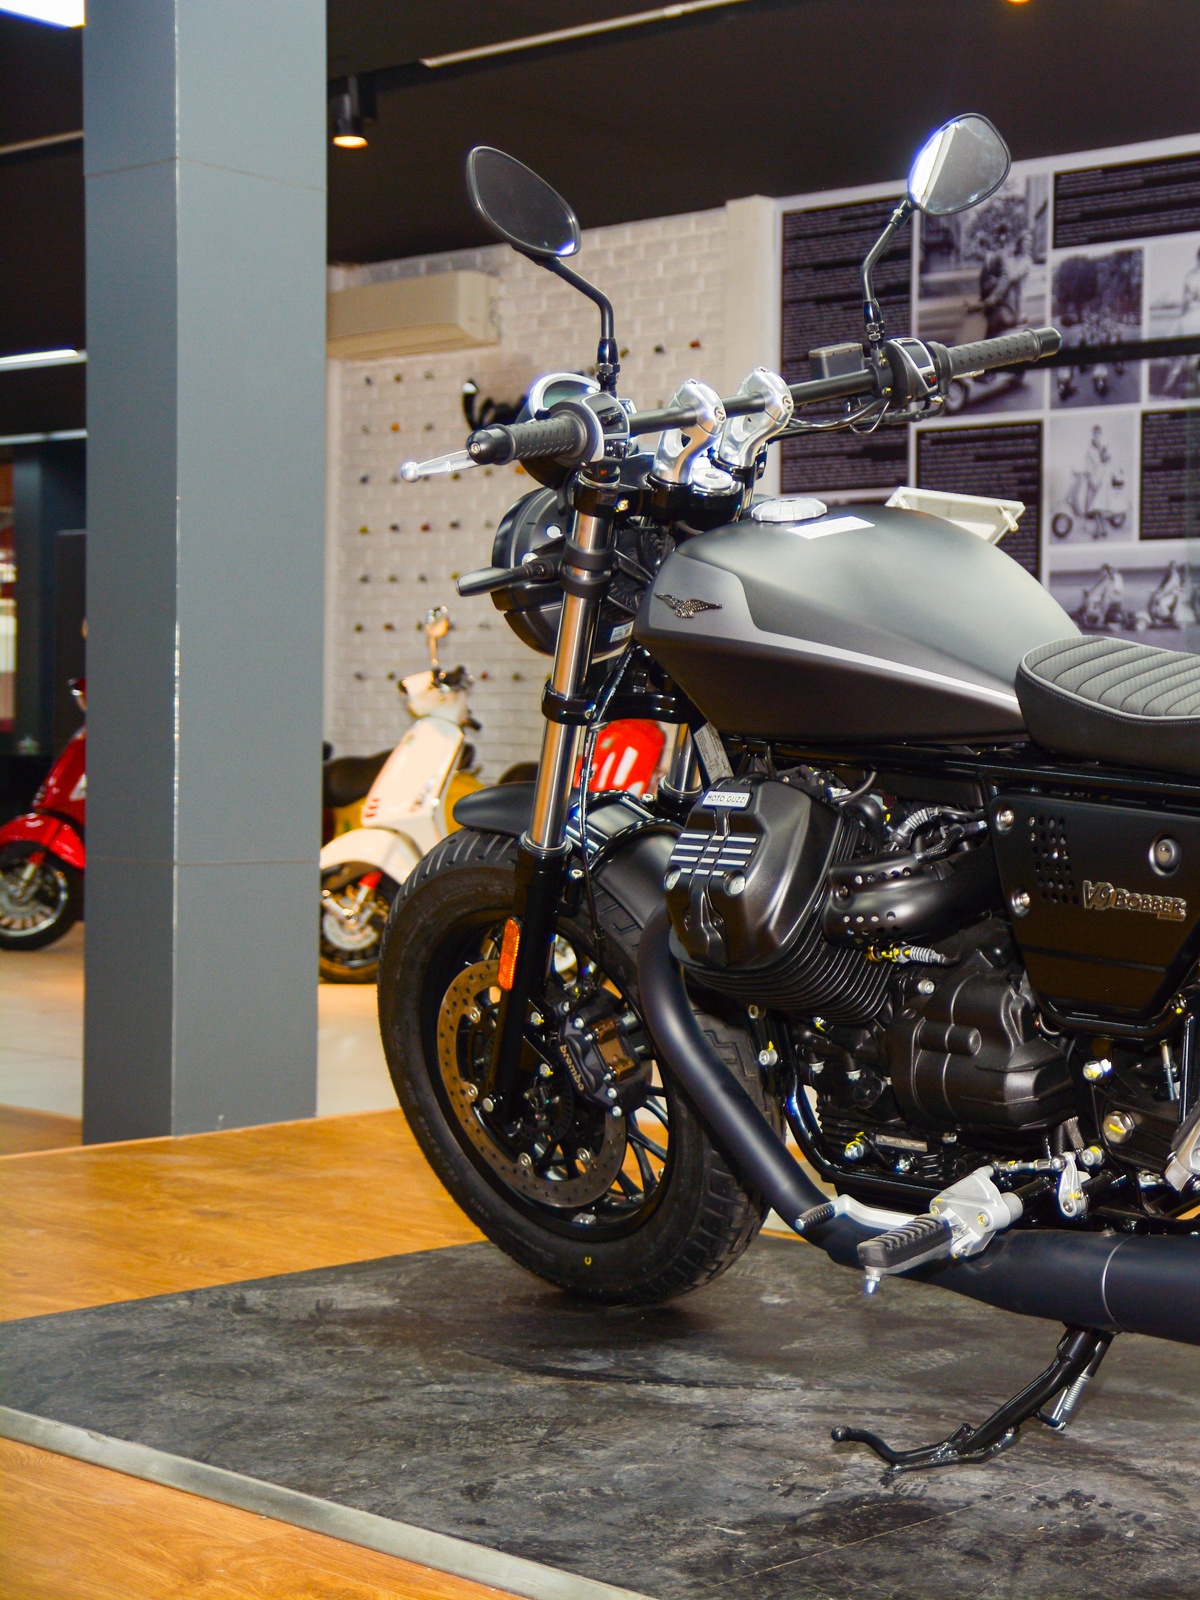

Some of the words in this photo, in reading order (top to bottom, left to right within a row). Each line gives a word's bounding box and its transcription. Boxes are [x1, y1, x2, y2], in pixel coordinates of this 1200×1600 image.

[706, 794, 726, 803] MOTO
[726, 795, 747, 804] GUZZI
[1082, 880, 1114, 911] V9
[559, 1043, 585, 1091] brembo
